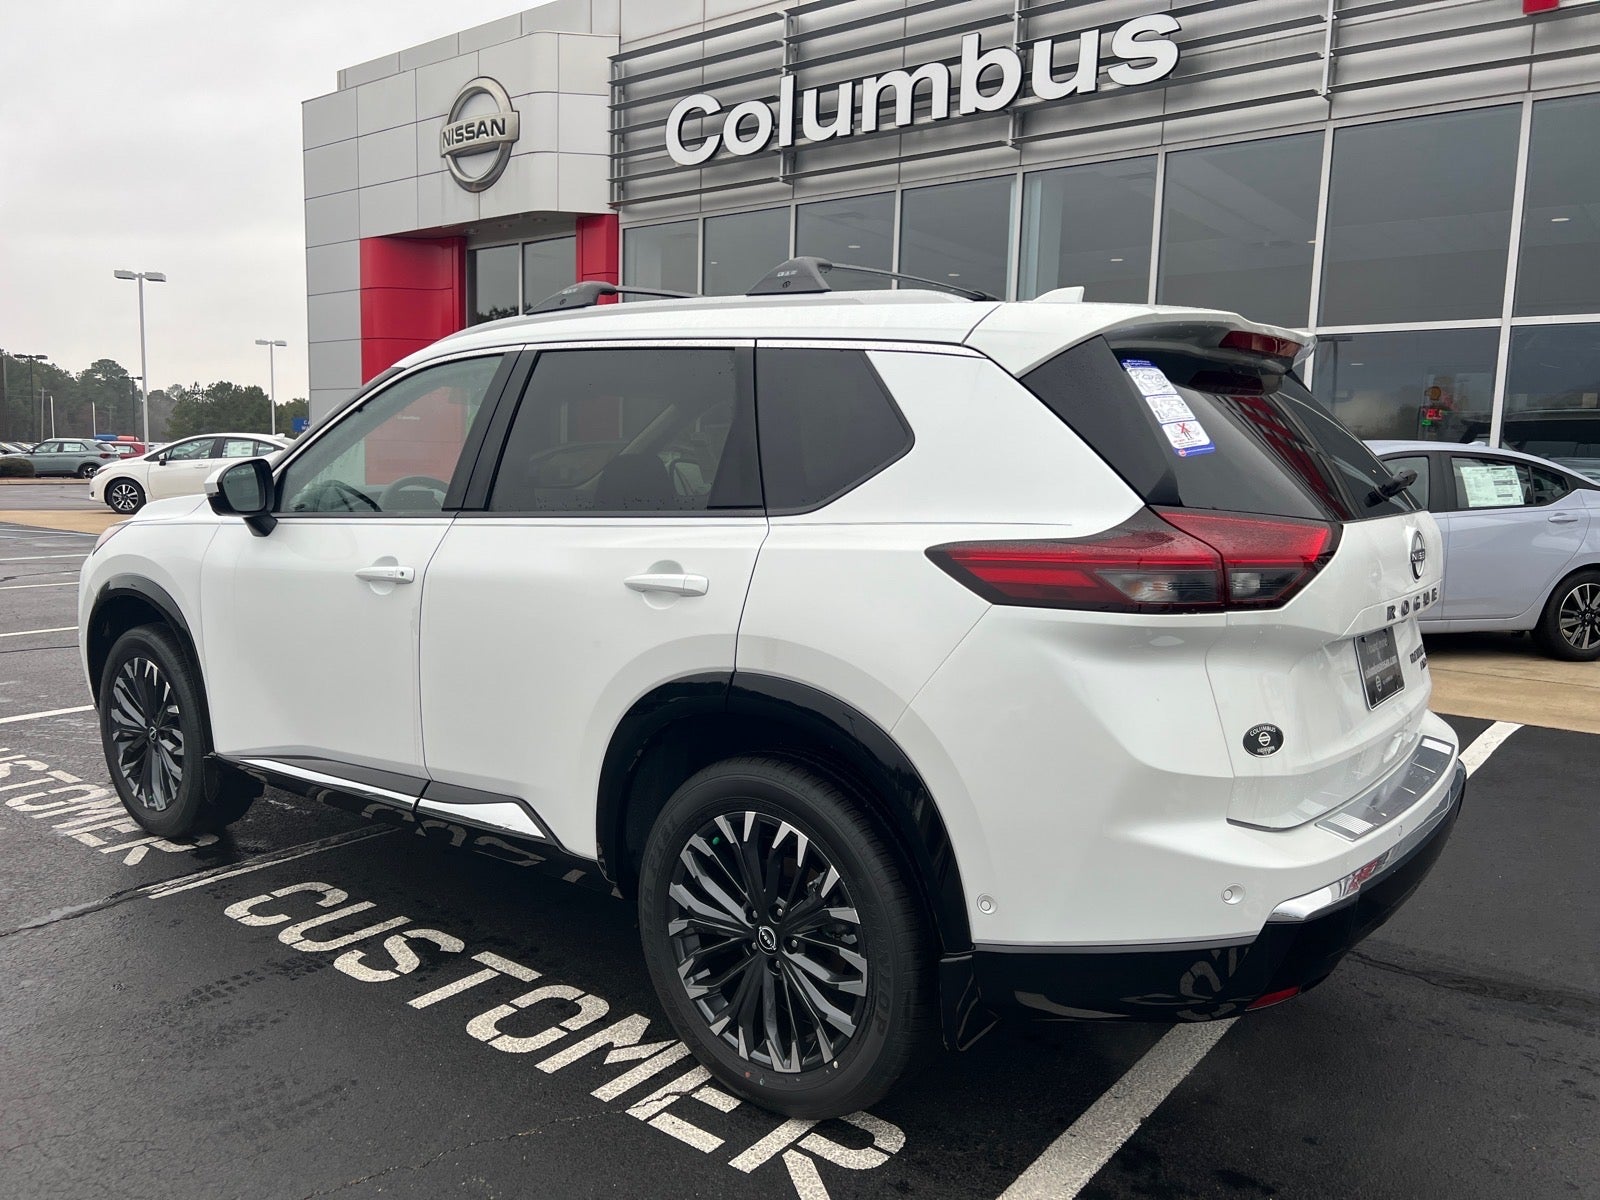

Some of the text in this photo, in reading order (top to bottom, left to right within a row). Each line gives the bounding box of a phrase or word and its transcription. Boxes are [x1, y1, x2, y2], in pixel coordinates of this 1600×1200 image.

[442, 118, 506, 149] NISSAN
[666, 14, 1181, 166] Columbus
[1387, 588, 1437, 621] ROGUE
[224, 882, 907, 1200] CUSTOMER
